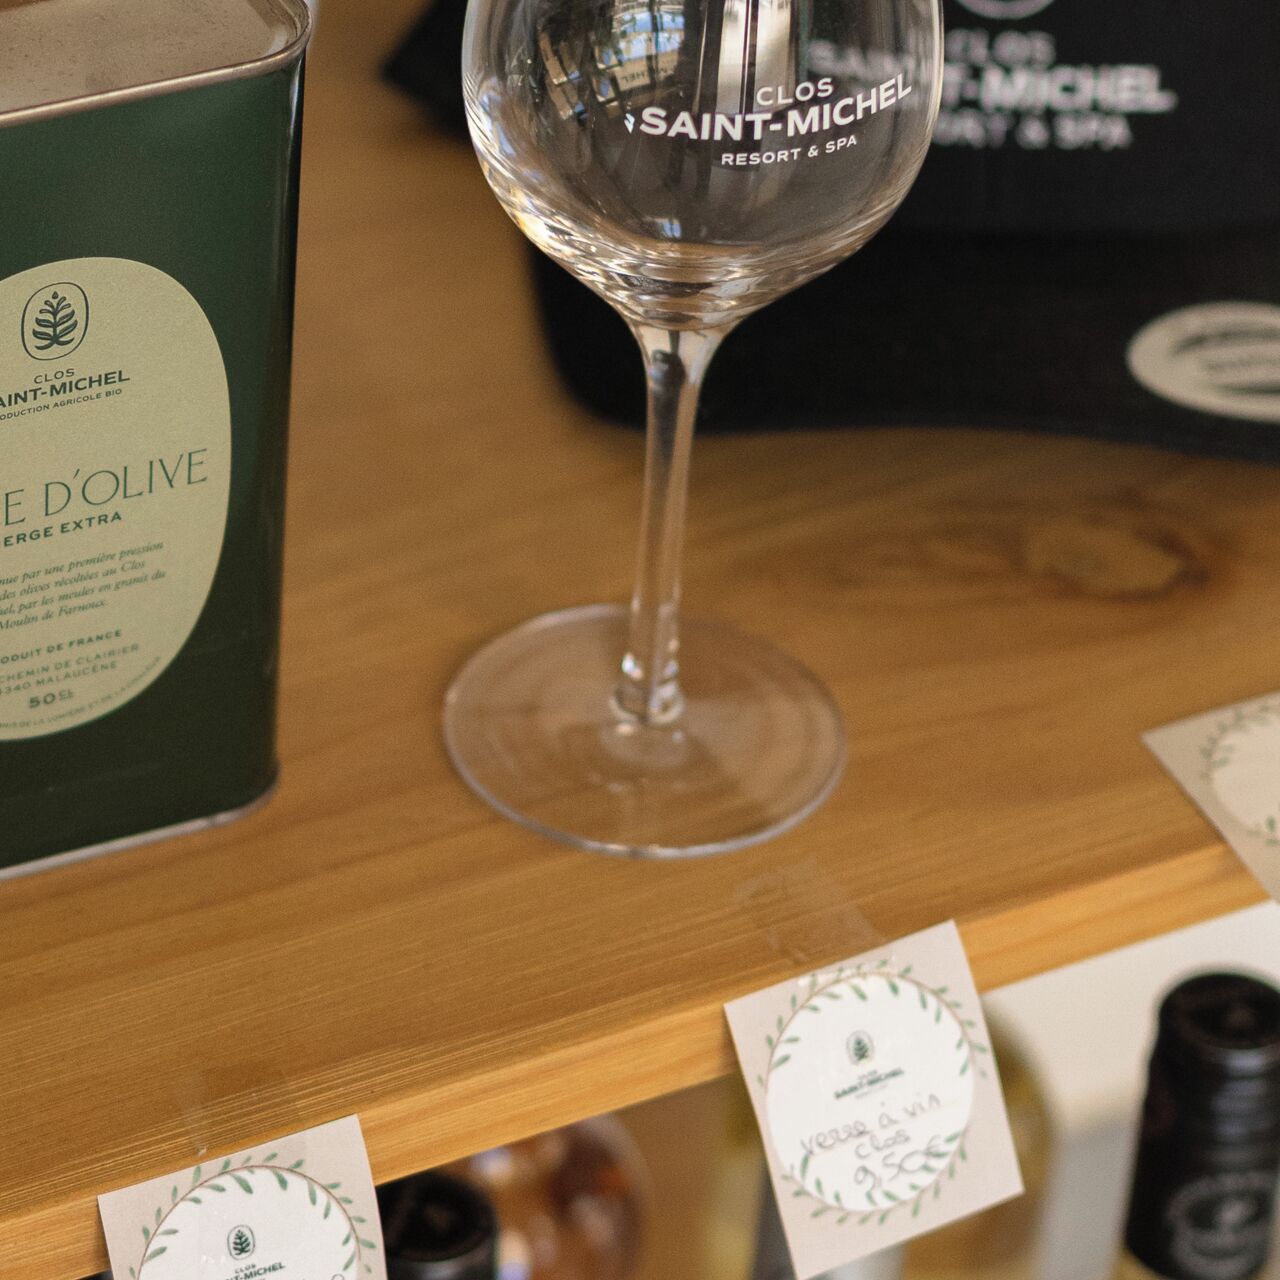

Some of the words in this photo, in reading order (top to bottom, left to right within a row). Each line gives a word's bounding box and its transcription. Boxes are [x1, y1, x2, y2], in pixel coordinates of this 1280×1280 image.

[756, 77, 835, 106] CLOS
[639, 73, 912, 142] SAINT-MICHEL
[721, 148, 801, 166] RESORT
[807, 145, 819, 158] &
[825, 135, 858, 153] SPA
[33, 368, 75, 384] CLOS
[52, 392, 102, 409] AGRICOLE
[105, 388, 122, 398] BIO
[44, 448, 208, 516] D'OLIVE
[60, 511, 123, 534] EXTRA
[22, 568, 42, 583] par
[44, 564, 65, 575] une
[68, 551, 116, 572] première
[118, 541, 164, 561] pression
[18, 599, 38, 614] par
[41, 594, 55, 606] les
[58, 584, 95, 602] meules
[98, 581, 111, 592] en
[151, 568, 166, 581] du
[20, 581, 50, 596] olives
[54, 570, 99, 589] récoltées
[101, 567, 117, 578] au
[120, 559, 146, 573] Clos
[41, 607, 54, 619] de
[46, 643, 64, 654] DE
[68, 629, 122, 648] FRANCE
[54, 659, 71, 670] DE
